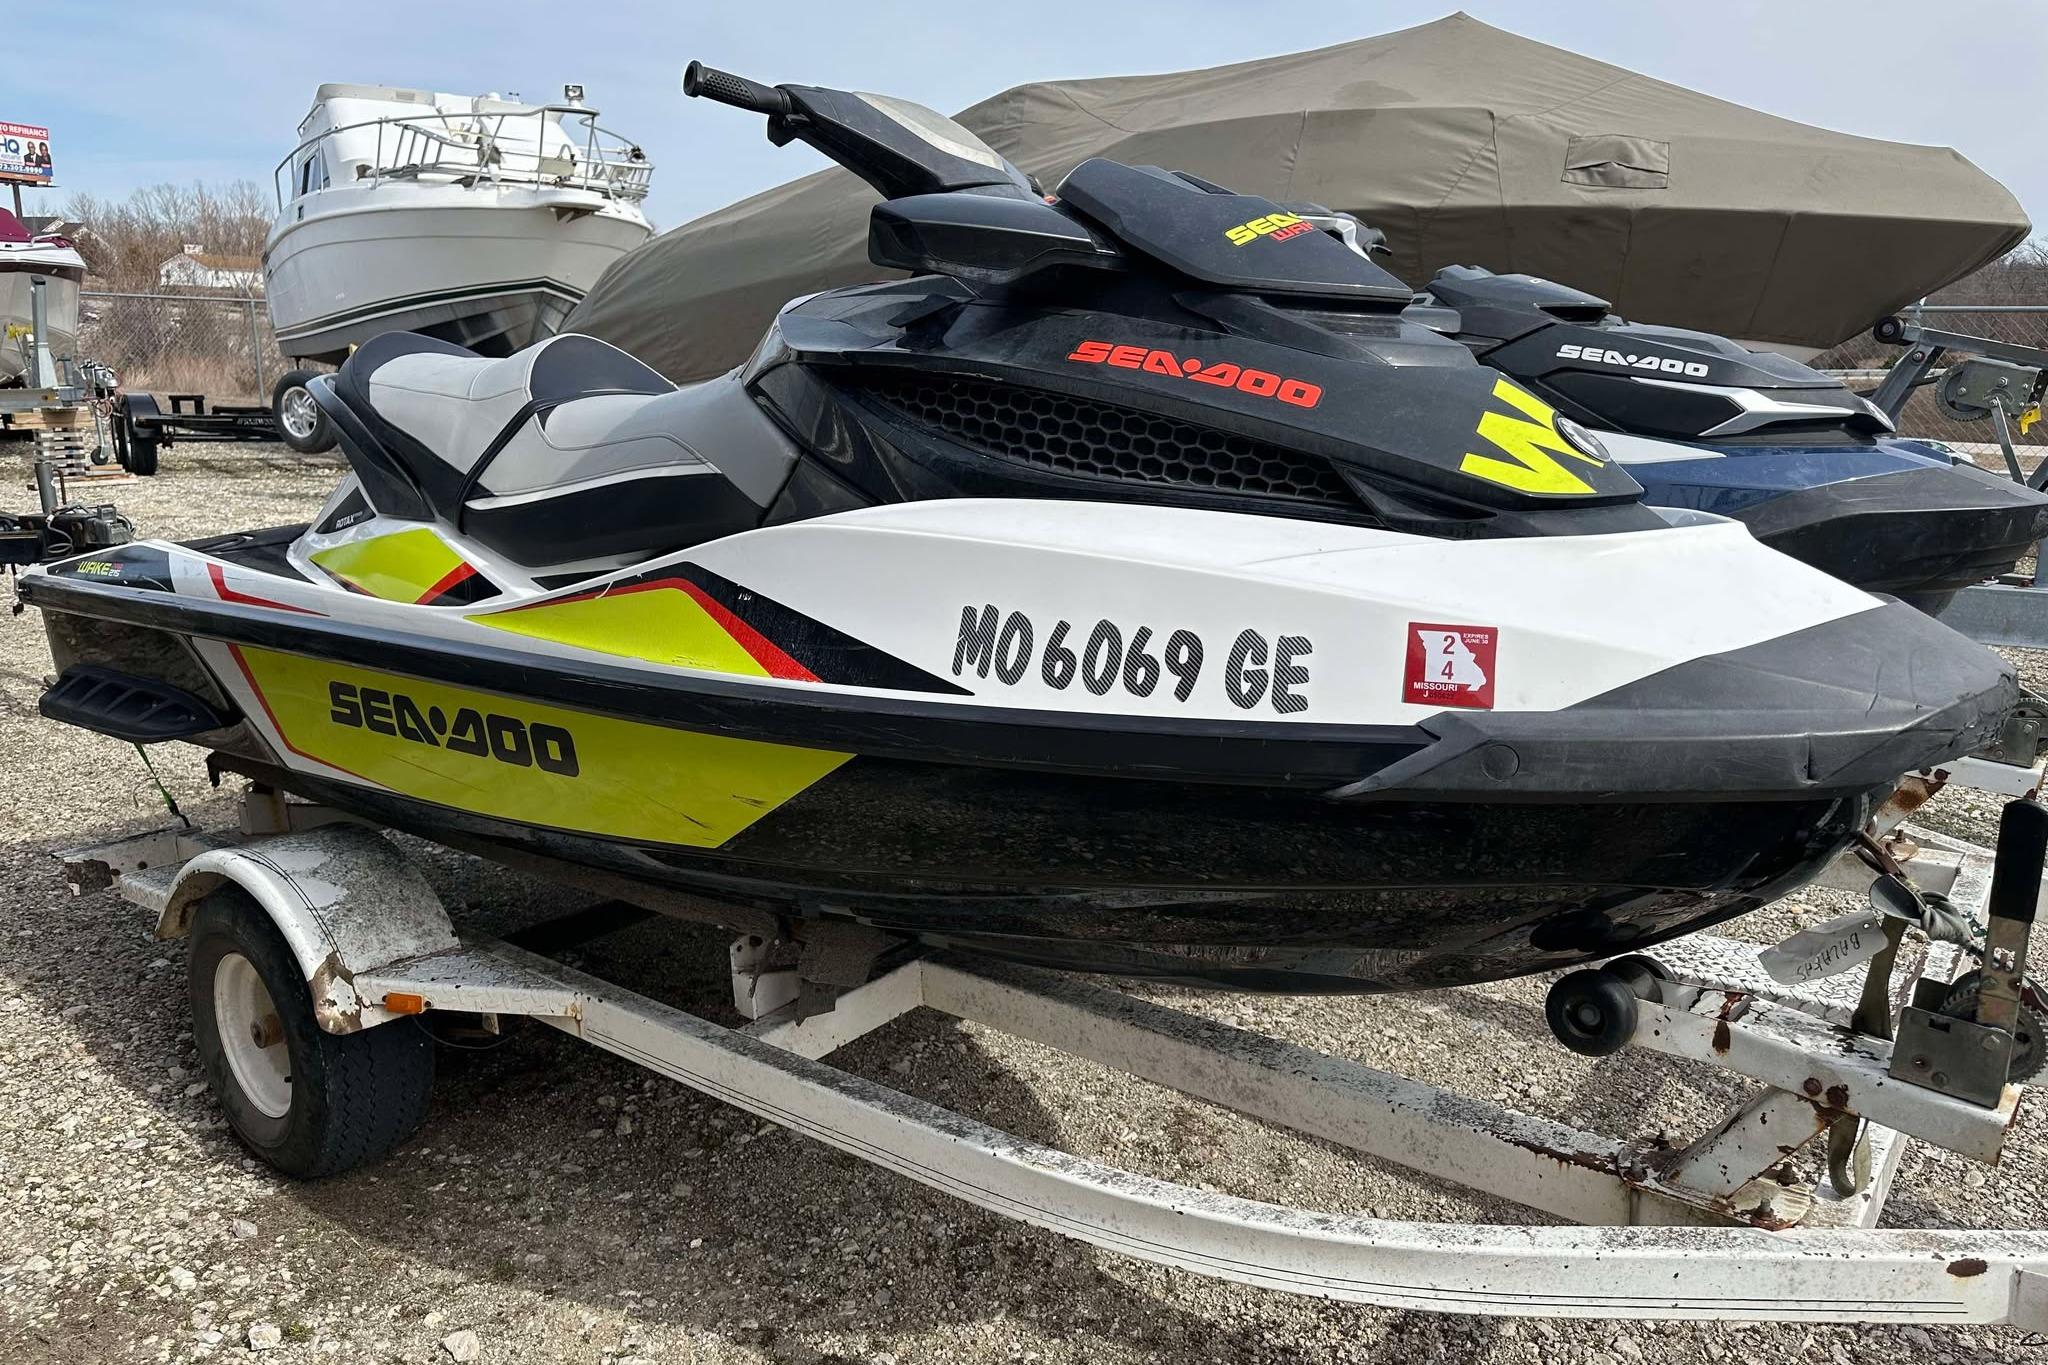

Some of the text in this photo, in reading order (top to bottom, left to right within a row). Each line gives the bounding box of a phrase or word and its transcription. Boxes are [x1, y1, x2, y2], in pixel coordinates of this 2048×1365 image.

[9, 125, 48, 137] REFINANCE
[77, 561, 112, 576] WAKE
[1443, 635, 1455, 654] 2
[951, 603, 1313, 714] MO 6069 GE
[1441, 660, 1454, 680] 4
[1413, 682, 1458, 691] MISSOURI
